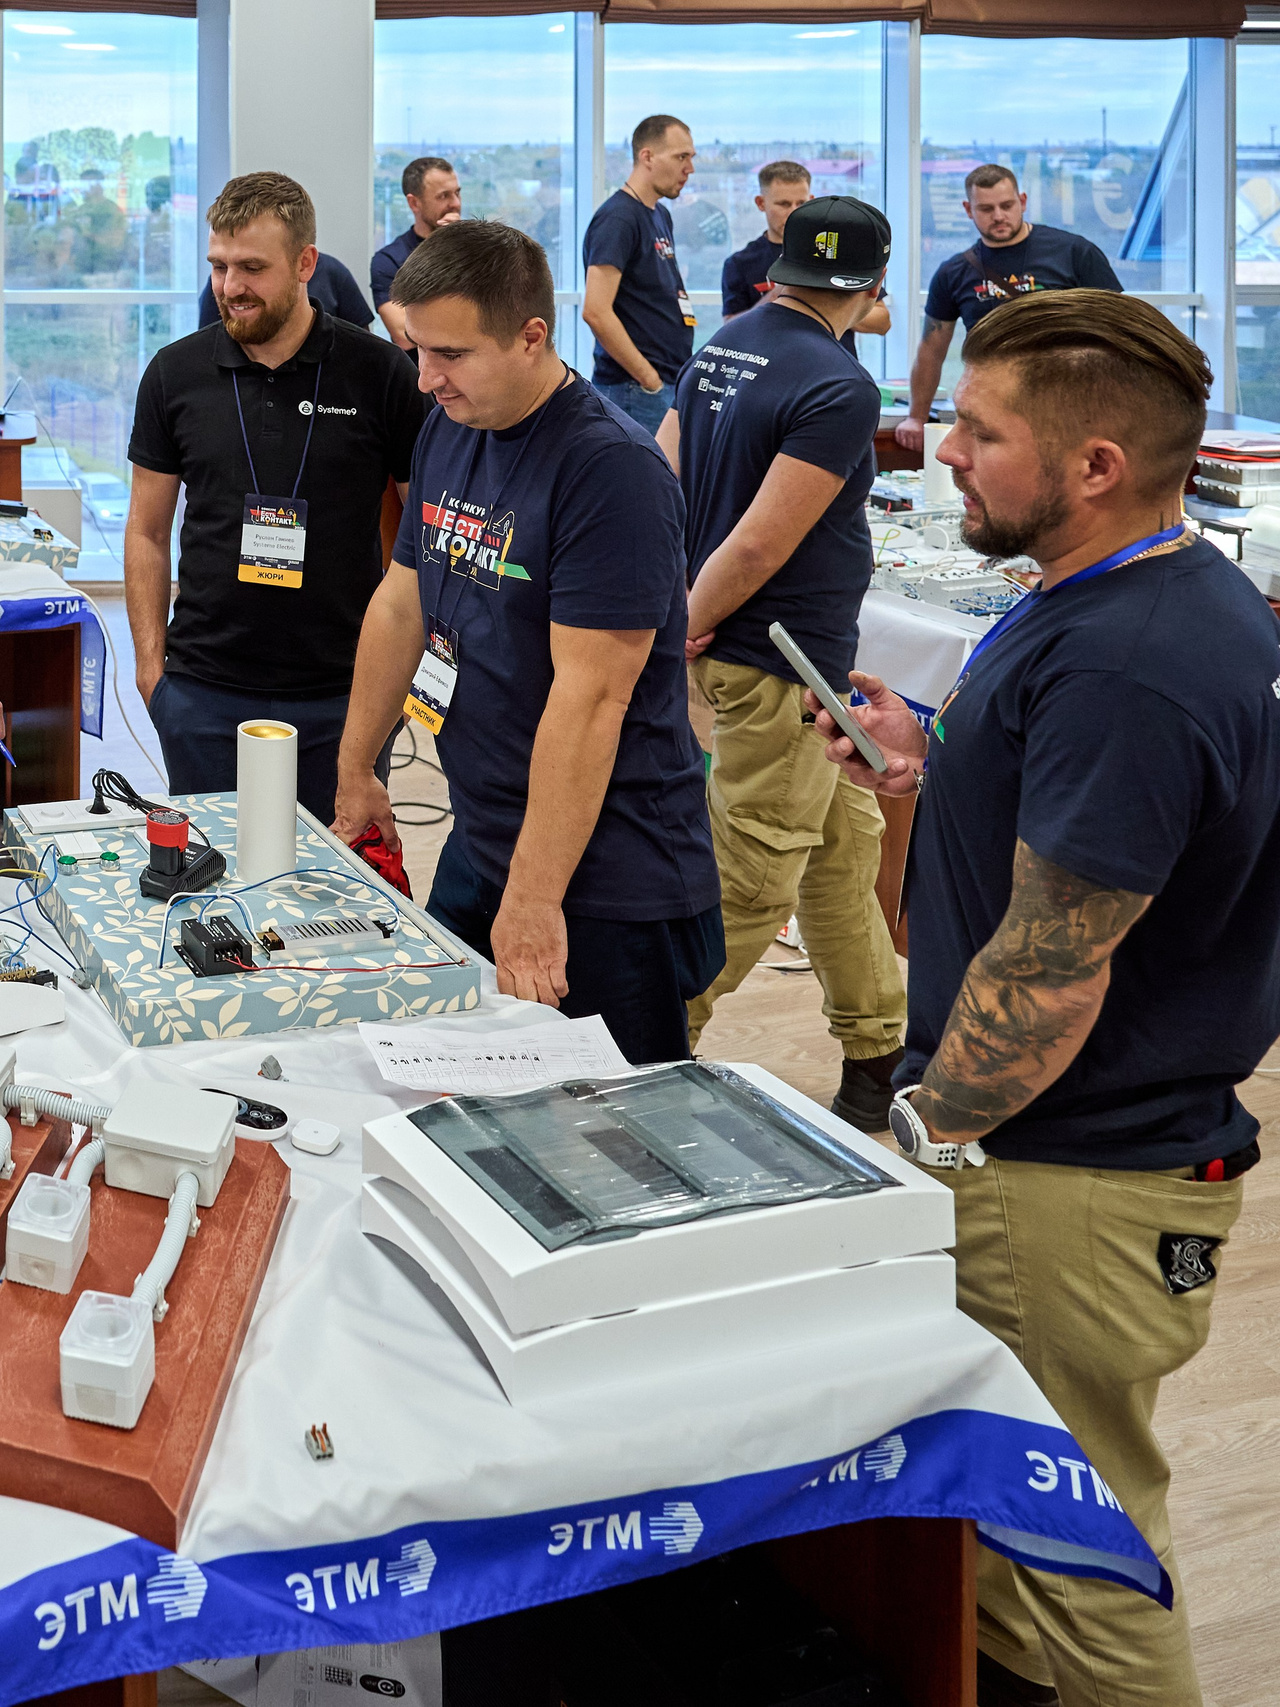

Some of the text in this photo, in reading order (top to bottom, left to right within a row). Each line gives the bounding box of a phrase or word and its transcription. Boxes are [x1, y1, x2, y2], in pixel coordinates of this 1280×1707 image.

[317, 404, 357, 416] Systeme9
[276, 543, 296, 551] Electric
[257, 571, 283, 581] ЖЮРИ
[44, 600, 79, 615] ЭТМ
[410, 703, 436, 727] УЧАСТНИК
[1025, 1450, 1124, 1513] ЭТМ
[548, 1510, 643, 1556] ЭТМ
[285, 1557, 380, 1614] ЭТМ
[34, 1573, 140, 1650] ЭТМ
